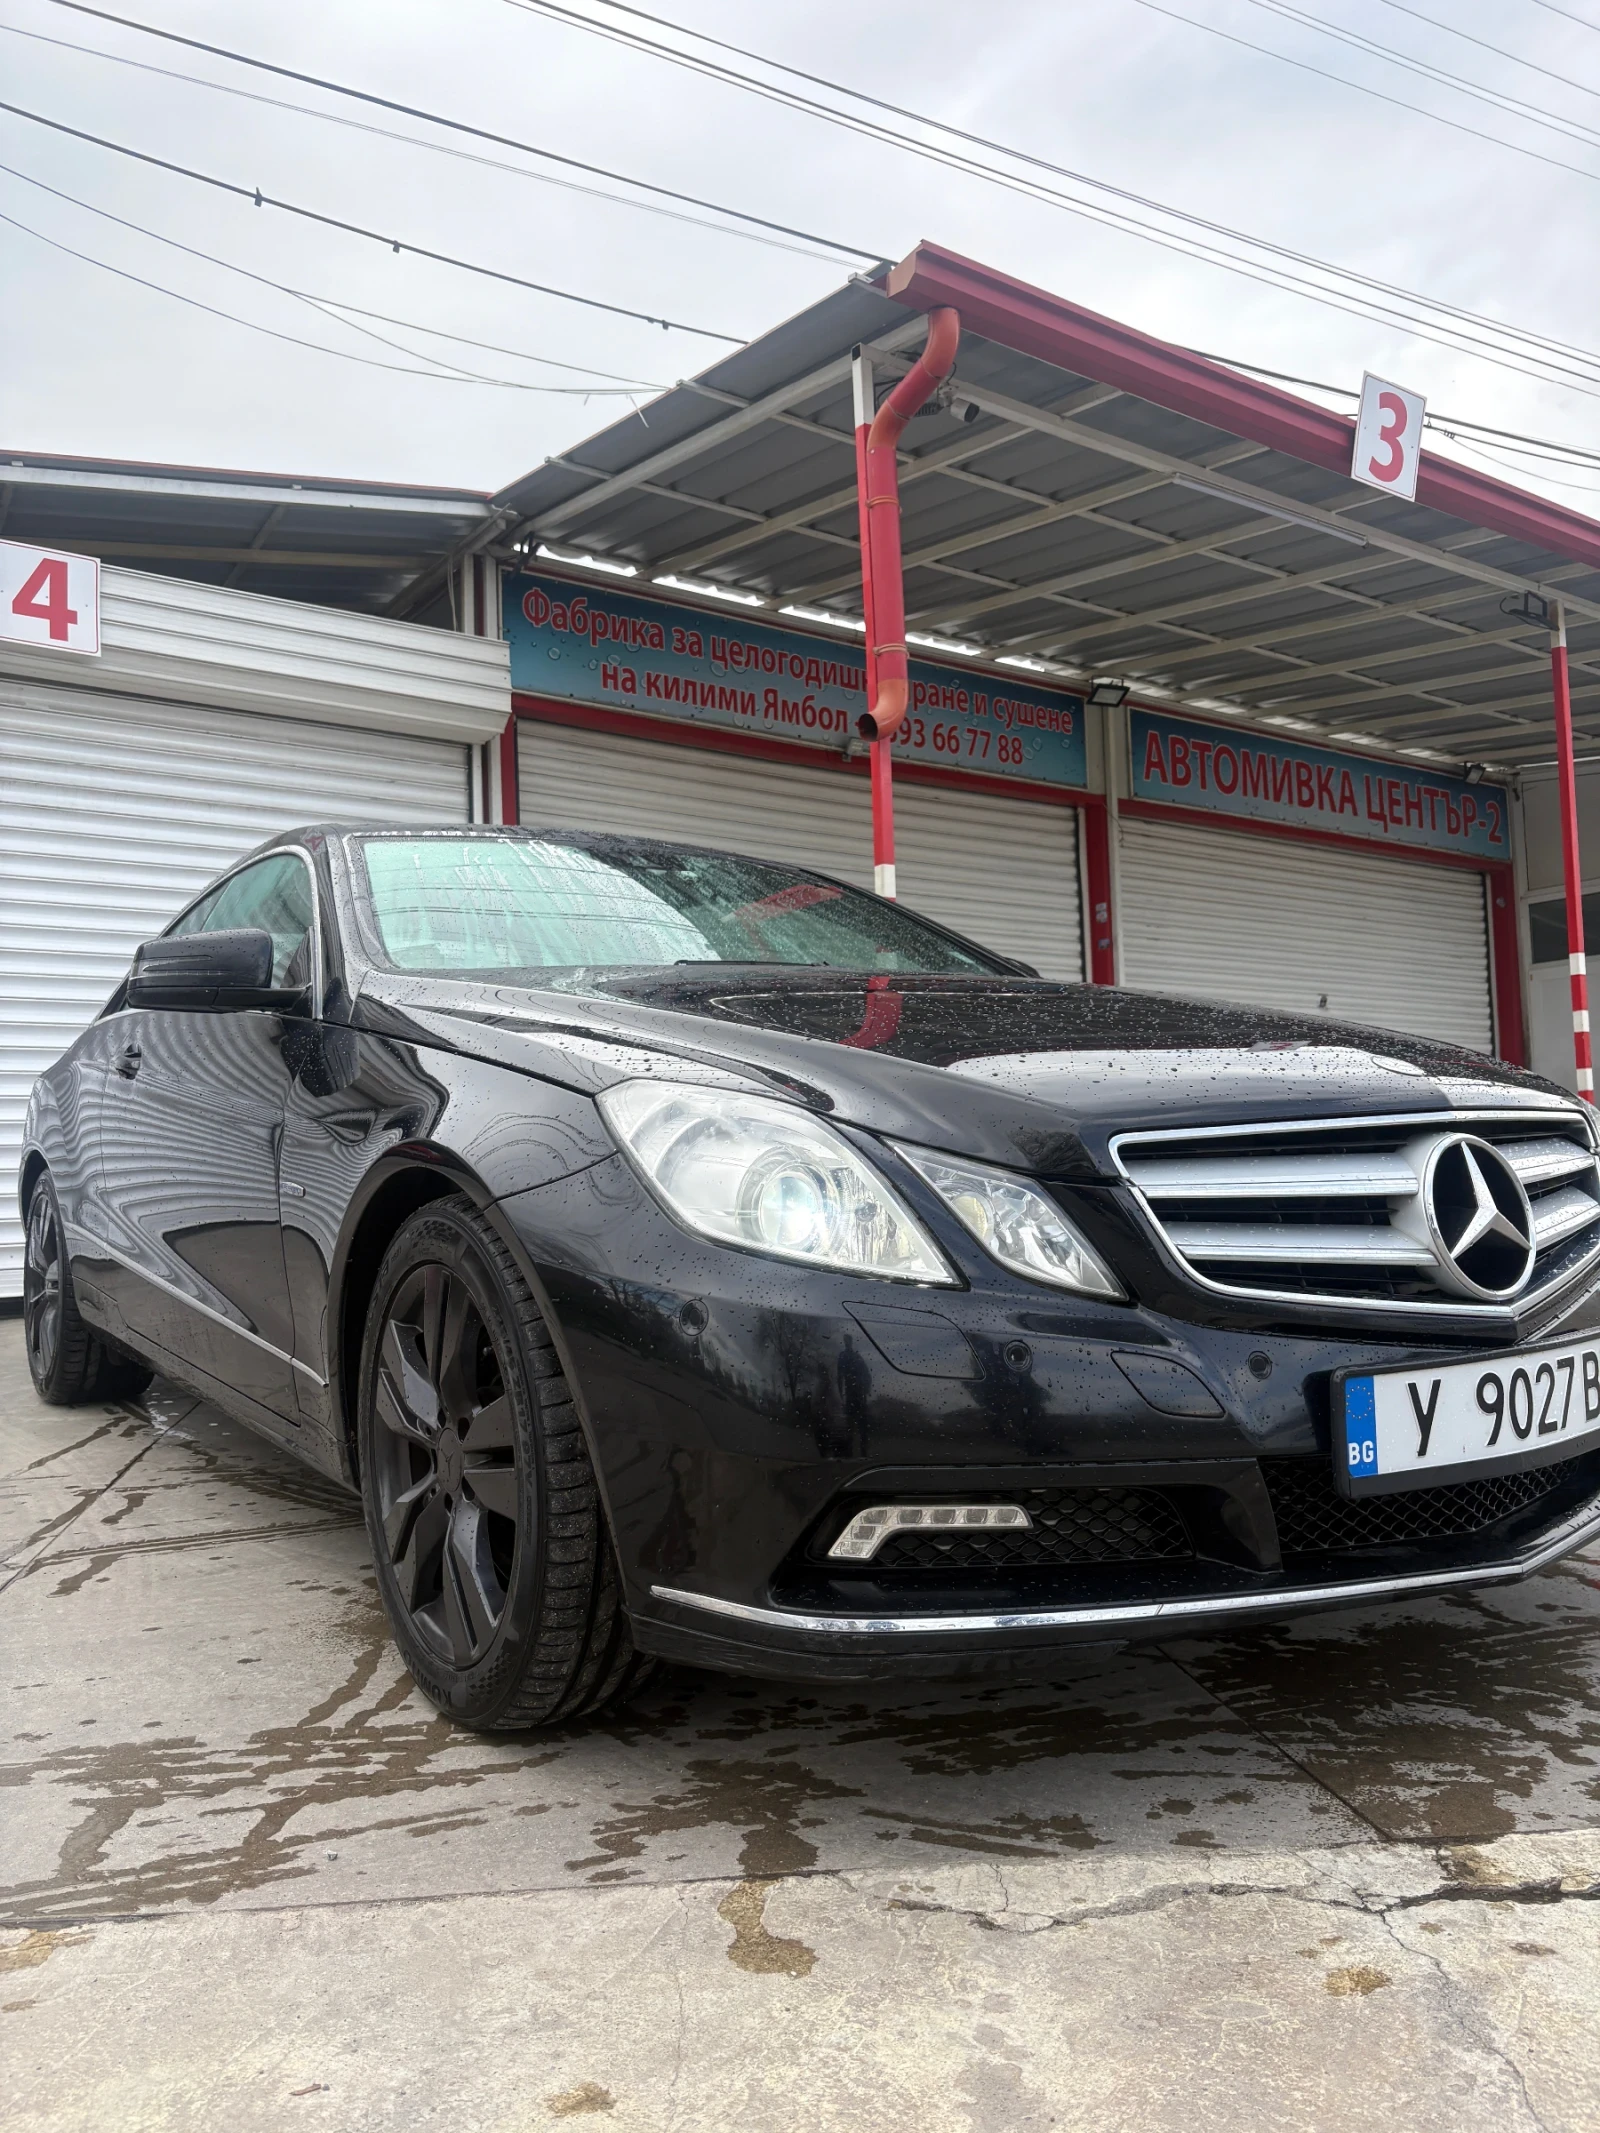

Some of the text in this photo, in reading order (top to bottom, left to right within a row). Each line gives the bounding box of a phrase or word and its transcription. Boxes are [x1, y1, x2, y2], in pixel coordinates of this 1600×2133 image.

[1369, 392, 1408, 483] 3
[12, 557, 78, 642] 4
[522, 587, 665, 650] Фабрика
[672, 627, 704, 658] за
[912, 681, 969, 713] ране
[974, 692, 988, 717] и
[993, 697, 1073, 735] сушене
[602, 662, 1024, 765] на килими Ямбол 93 66 77 88
[1143, 730, 1503, 844] АВТОМИВКА ЦЕНТЪР-2
[1348, 1440, 1374, 1465] BG
